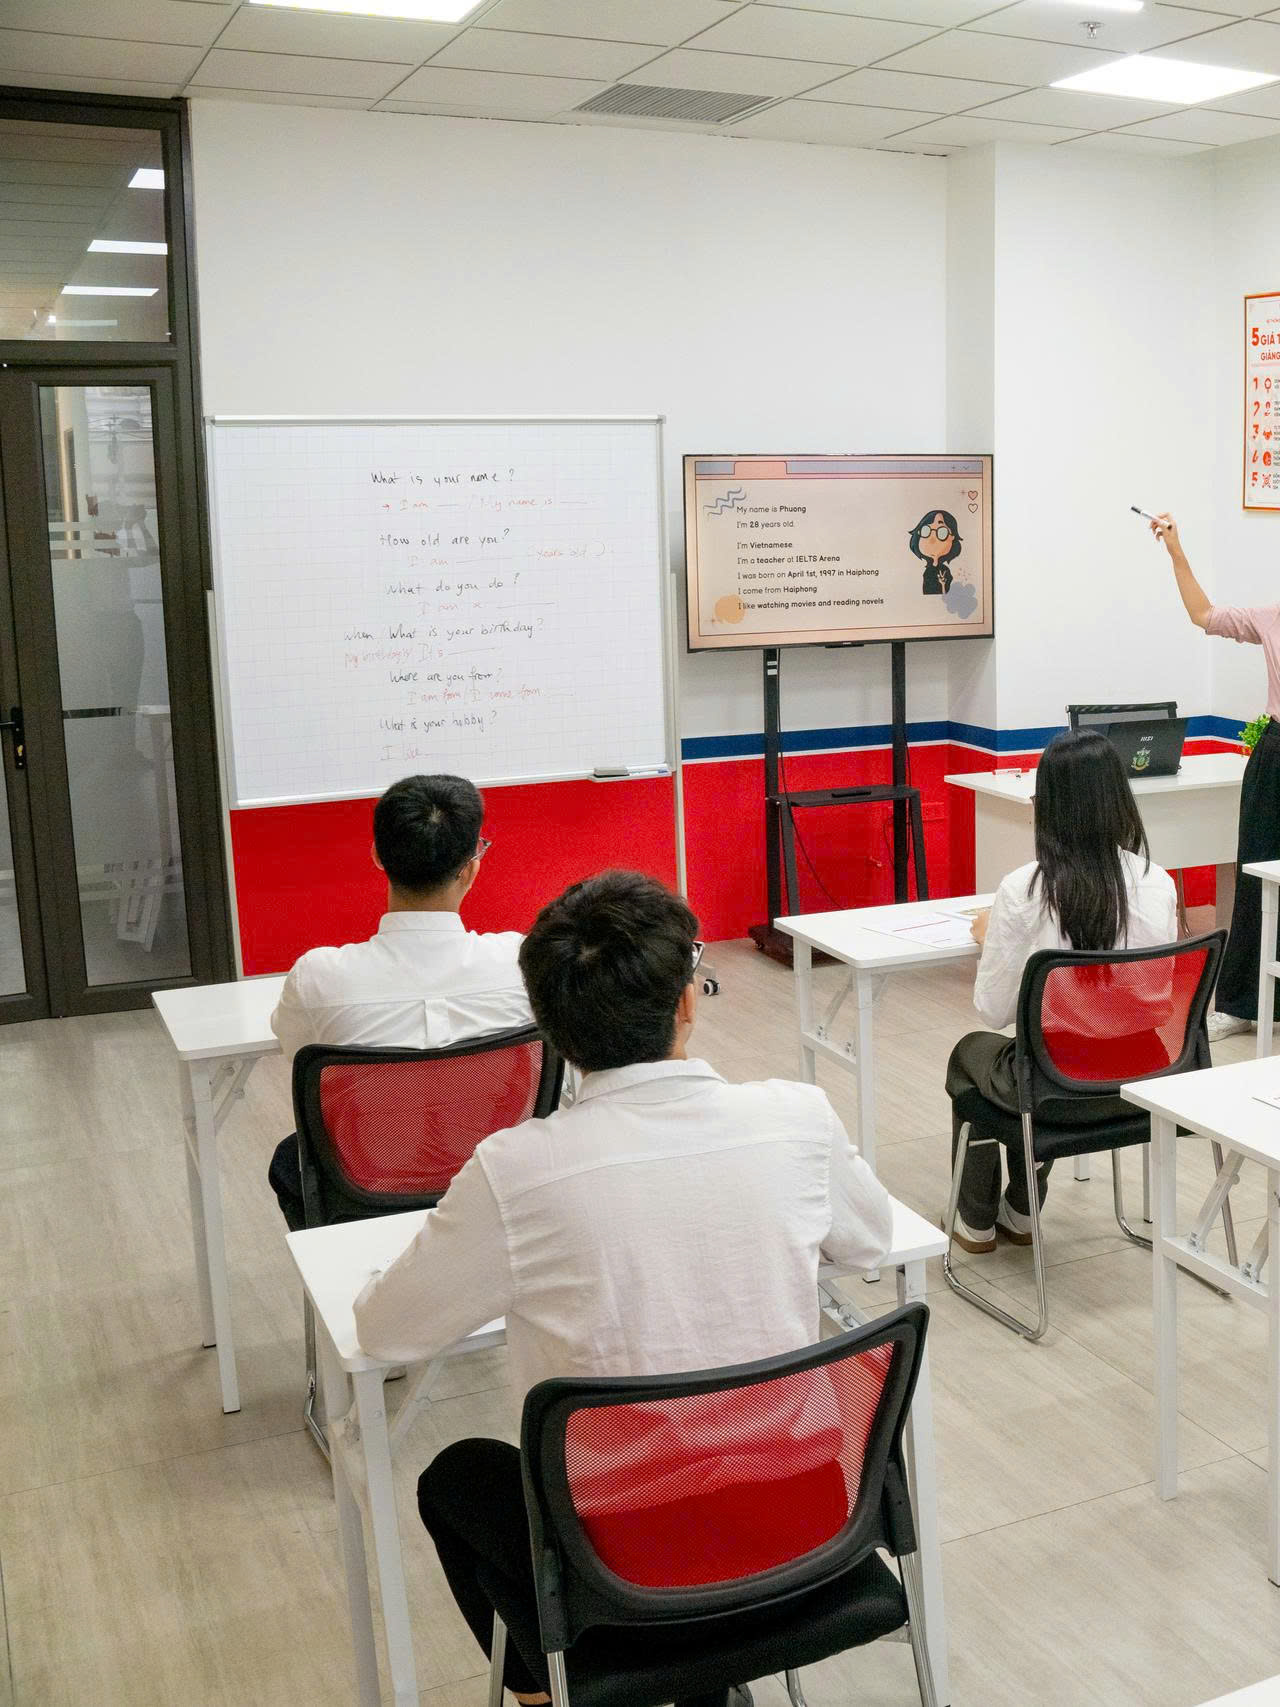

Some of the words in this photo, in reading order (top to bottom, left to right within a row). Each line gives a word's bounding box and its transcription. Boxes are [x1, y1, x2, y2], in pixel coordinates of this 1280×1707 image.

[1251, 327, 1260, 347] 5
[1260, 331, 1275, 346] GIÁ
[1253, 377, 1258, 390] 1
[371, 472, 400, 484] What
[410, 472, 423, 485] is
[432, 474, 462, 488] your
[470, 472, 499, 482] name
[736, 506, 747, 514] My
[779, 505, 807, 514] Phuong
[761, 521, 781, 529] years
[420, 534, 440, 547] old
[451, 536, 470, 545] are
[750, 541, 793, 549] Vietnamese
[796, 555, 818, 563] IELTS
[787, 571, 804, 579] April
[806, 570, 818, 578] 1st,
[846, 569, 879, 577] Haiphong
[435, 581, 451, 592] do
[456, 583, 479, 596] you
[488, 577, 504, 589] do
[783, 586, 818, 594] Haiphong
[757, 601, 790, 610] watching
[818, 599, 832, 607] and
[833, 598, 860, 607] reading
[389, 623, 416, 639] What
[428, 625, 438, 637] is
[446, 628, 474, 641] your
[390, 670, 418, 683] Where
[426, 673, 442, 682] are
[446, 674, 465, 688] you
